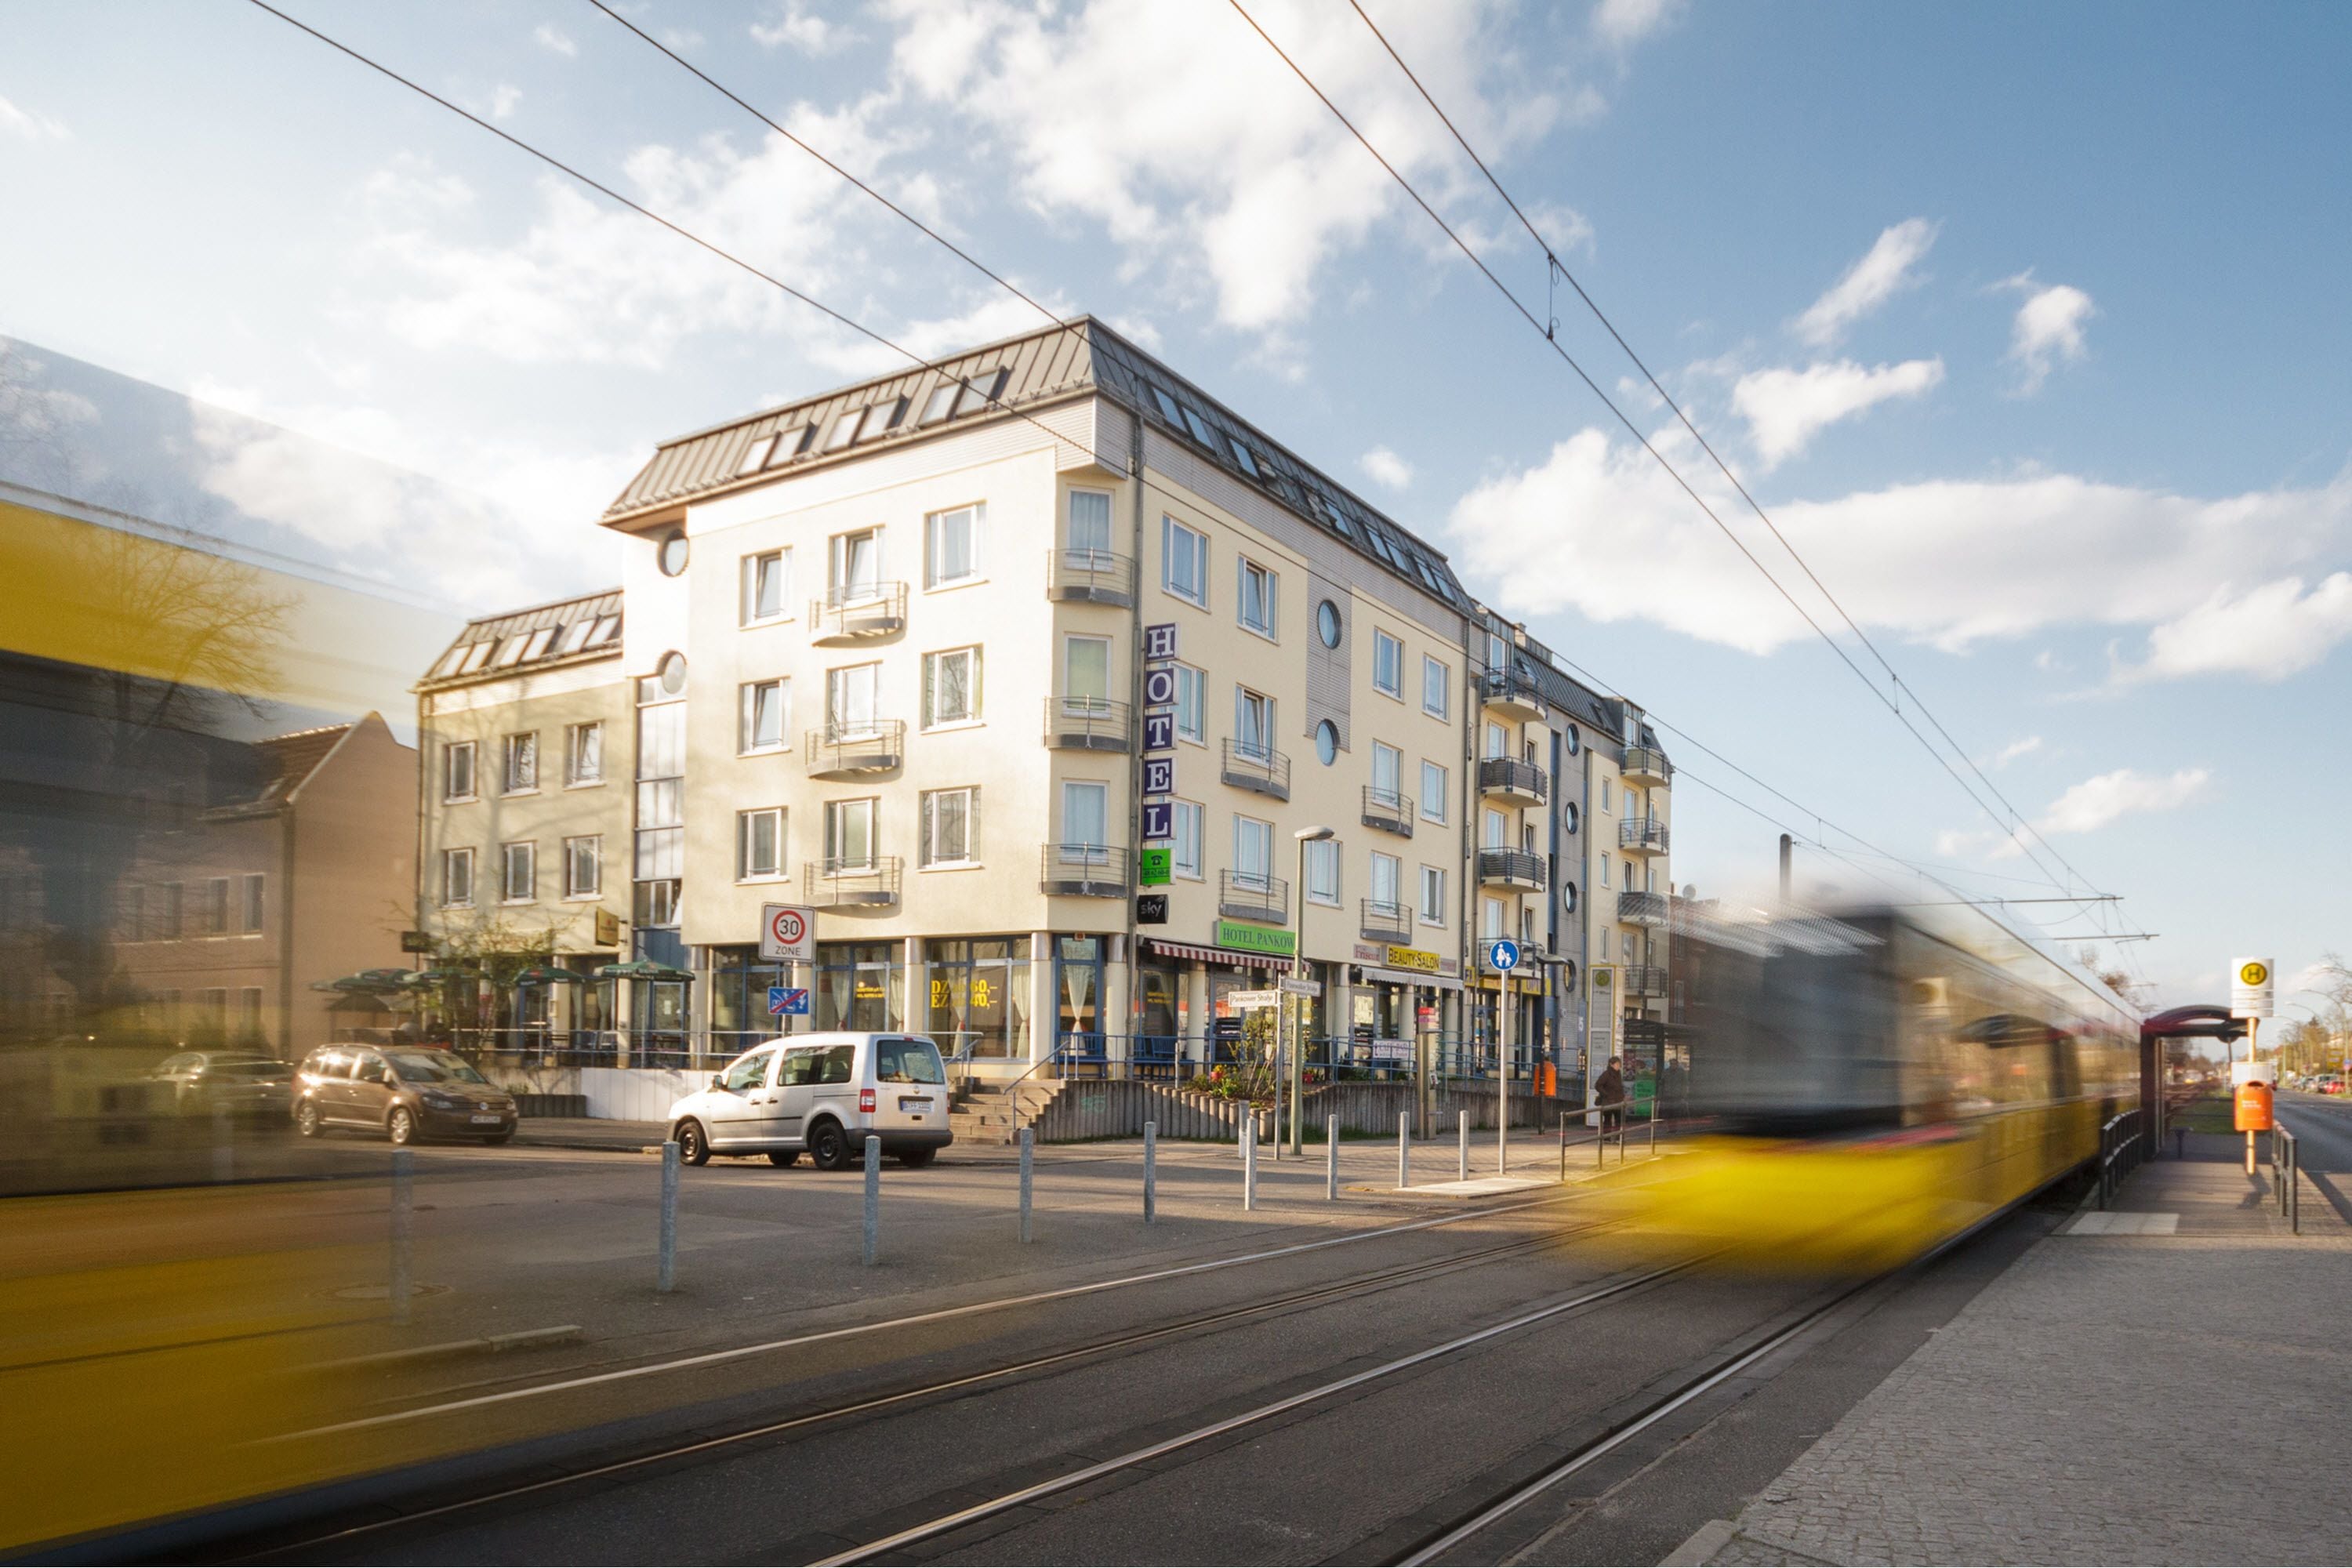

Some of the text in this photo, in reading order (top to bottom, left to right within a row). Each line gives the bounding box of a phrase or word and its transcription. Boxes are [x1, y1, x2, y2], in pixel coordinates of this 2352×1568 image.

[1148, 626, 1174, 837] HOTEL
[1142, 901, 1162, 917] sky
[779, 919, 799, 935] 30
[1223, 927, 1294, 949] HOTEL PANKOW
[775, 946, 801, 956] ZONE
[2248, 967, 2259, 979] H
[931, 981, 949, 993] DZ
[931, 994, 949, 1008] EZ
